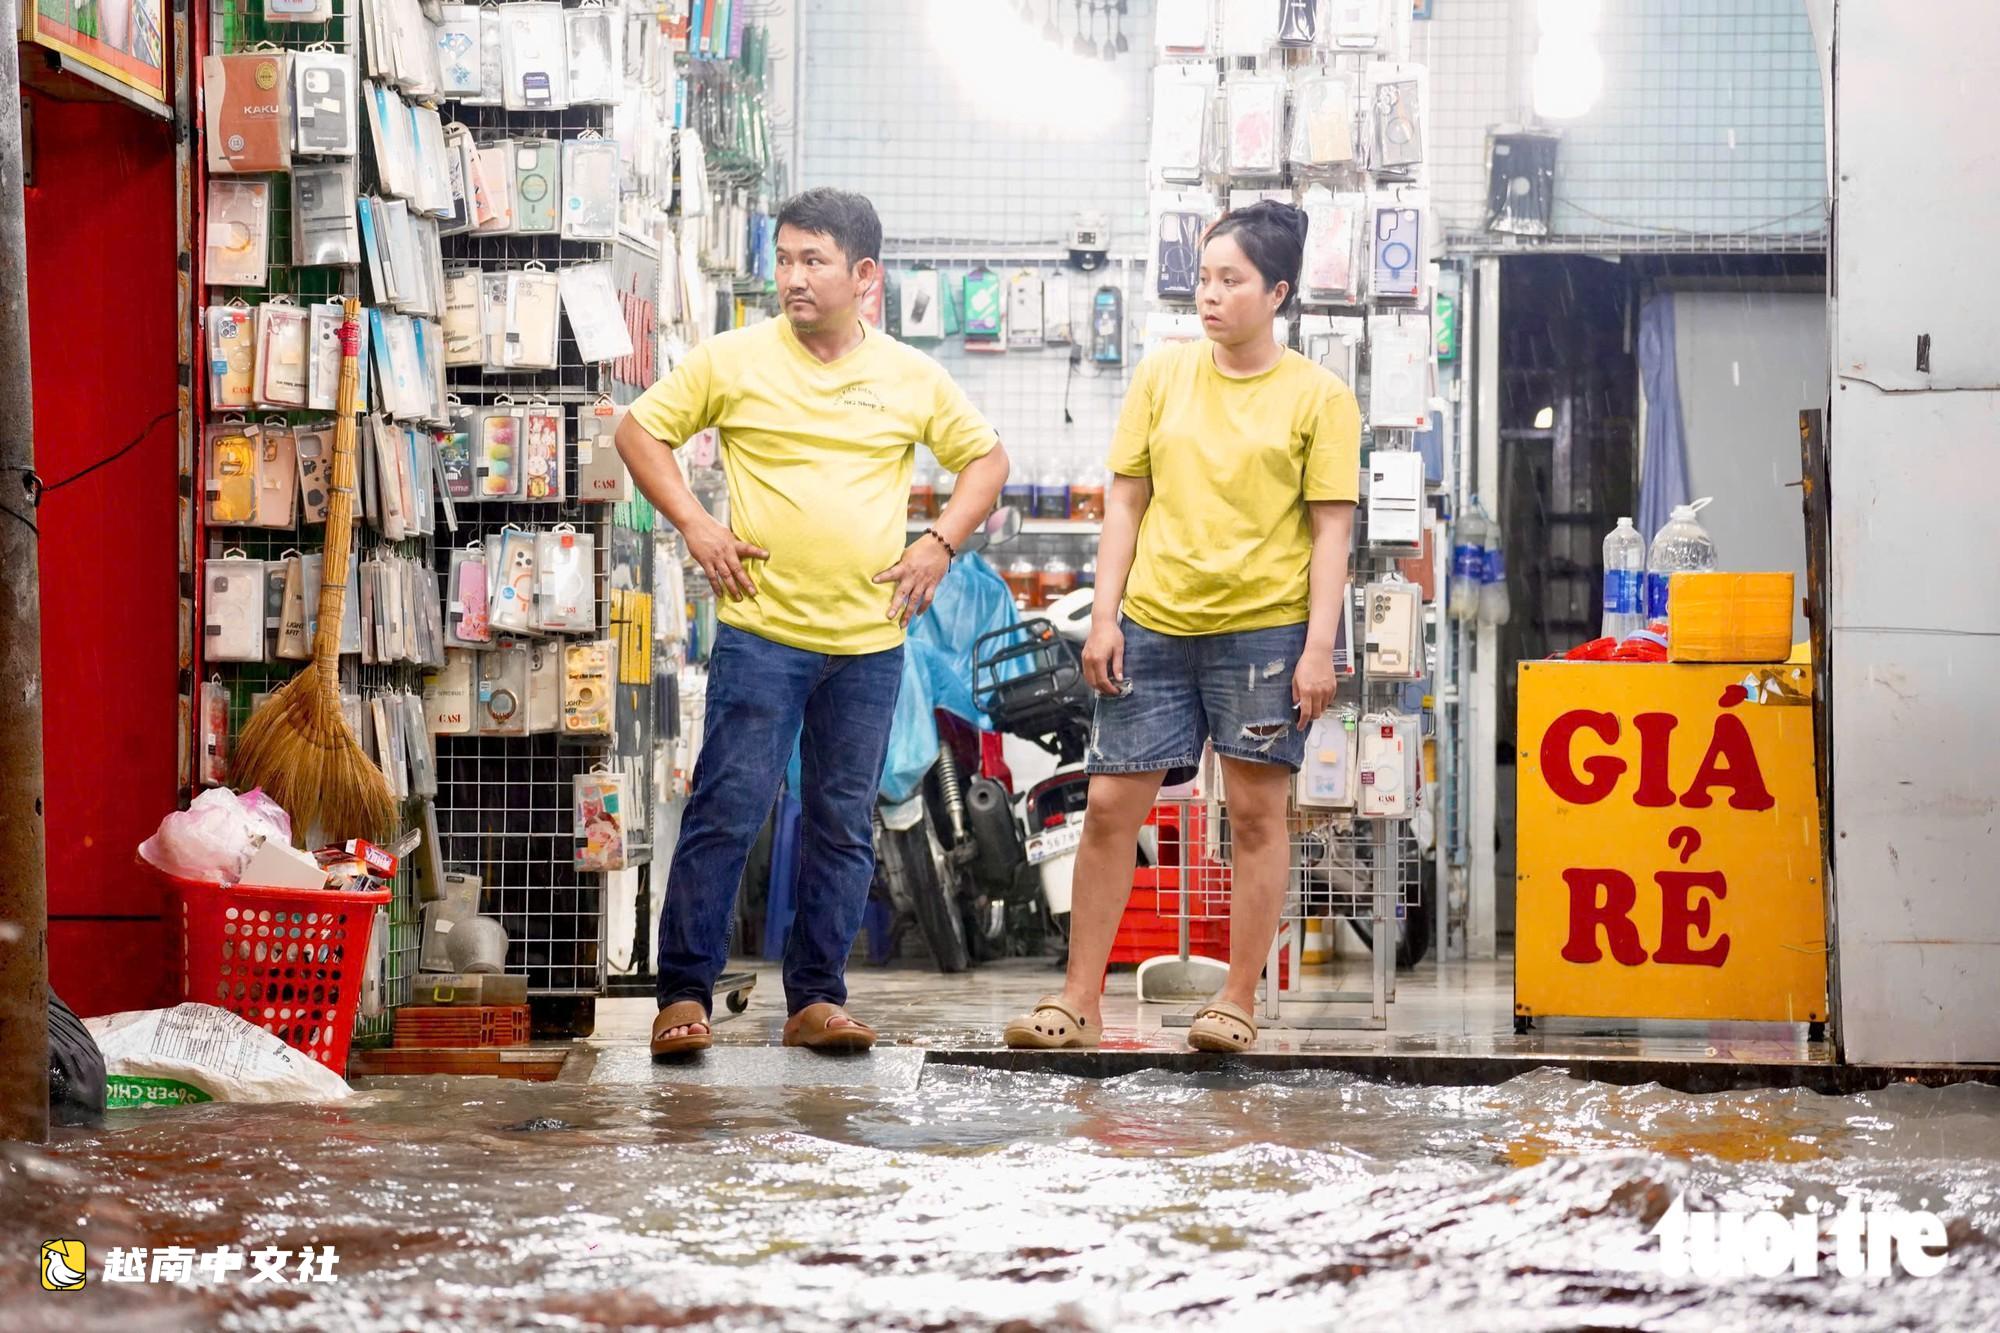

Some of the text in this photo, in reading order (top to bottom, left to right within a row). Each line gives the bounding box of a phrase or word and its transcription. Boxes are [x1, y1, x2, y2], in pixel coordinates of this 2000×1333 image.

[244, 105, 279, 114] KAKU
[1540, 684, 1775, 811] GIÁ
[1561, 826, 1731, 968] RẺ
